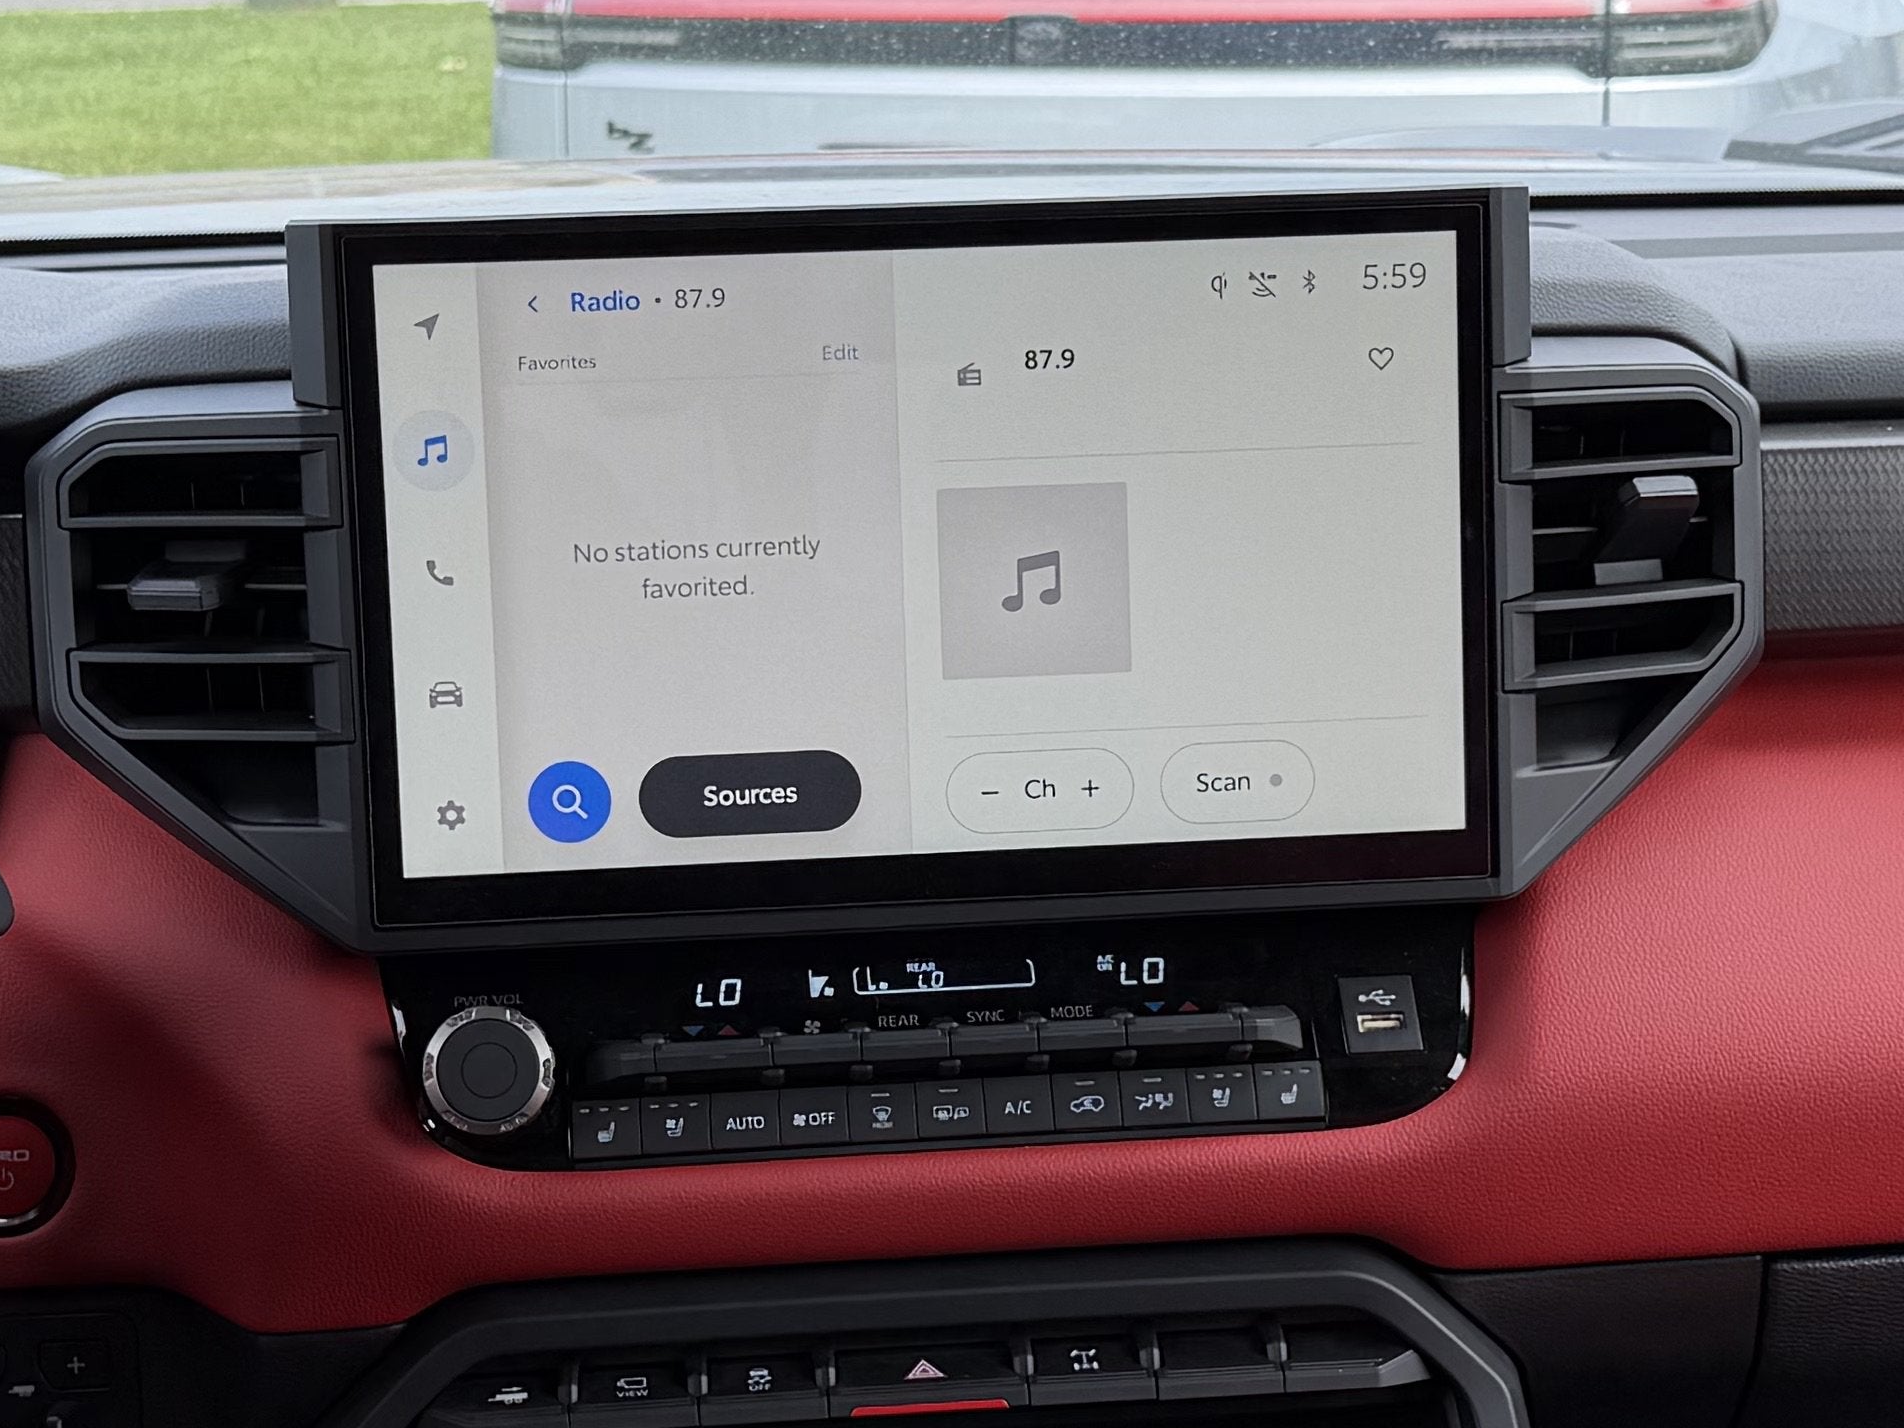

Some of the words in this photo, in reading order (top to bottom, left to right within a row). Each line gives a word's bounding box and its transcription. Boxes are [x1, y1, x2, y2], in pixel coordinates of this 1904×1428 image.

[1362, 262, 1428, 292] 5:59
[569, 289, 641, 314] Radio
[673, 286, 727, 310] 87.9
[517, 352, 598, 373] Favorites
[821, 343, 860, 363] Edit
[1023, 346, 1076, 371] 87.9
[572, 538, 607, 564] No
[613, 535, 710, 563] stations
[715, 532, 822, 567] currently
[641, 572, 755, 601] favorited.
[1024, 775, 1057, 800] Ch
[1194, 769, 1252, 794] Scan
[702, 782, 798, 809] Sources
[453, 994, 488, 1008] PWR
[492, 992, 524, 1005] VOL
[877, 1013, 920, 1028] REAR
[966, 1009, 1006, 1024] SYNC
[1050, 1004, 1094, 1019] MODE
[809, 1111, 837, 1127] OFF
[1004, 1100, 1033, 1117] A/C
[725, 1114, 766, 1131] AUTO
